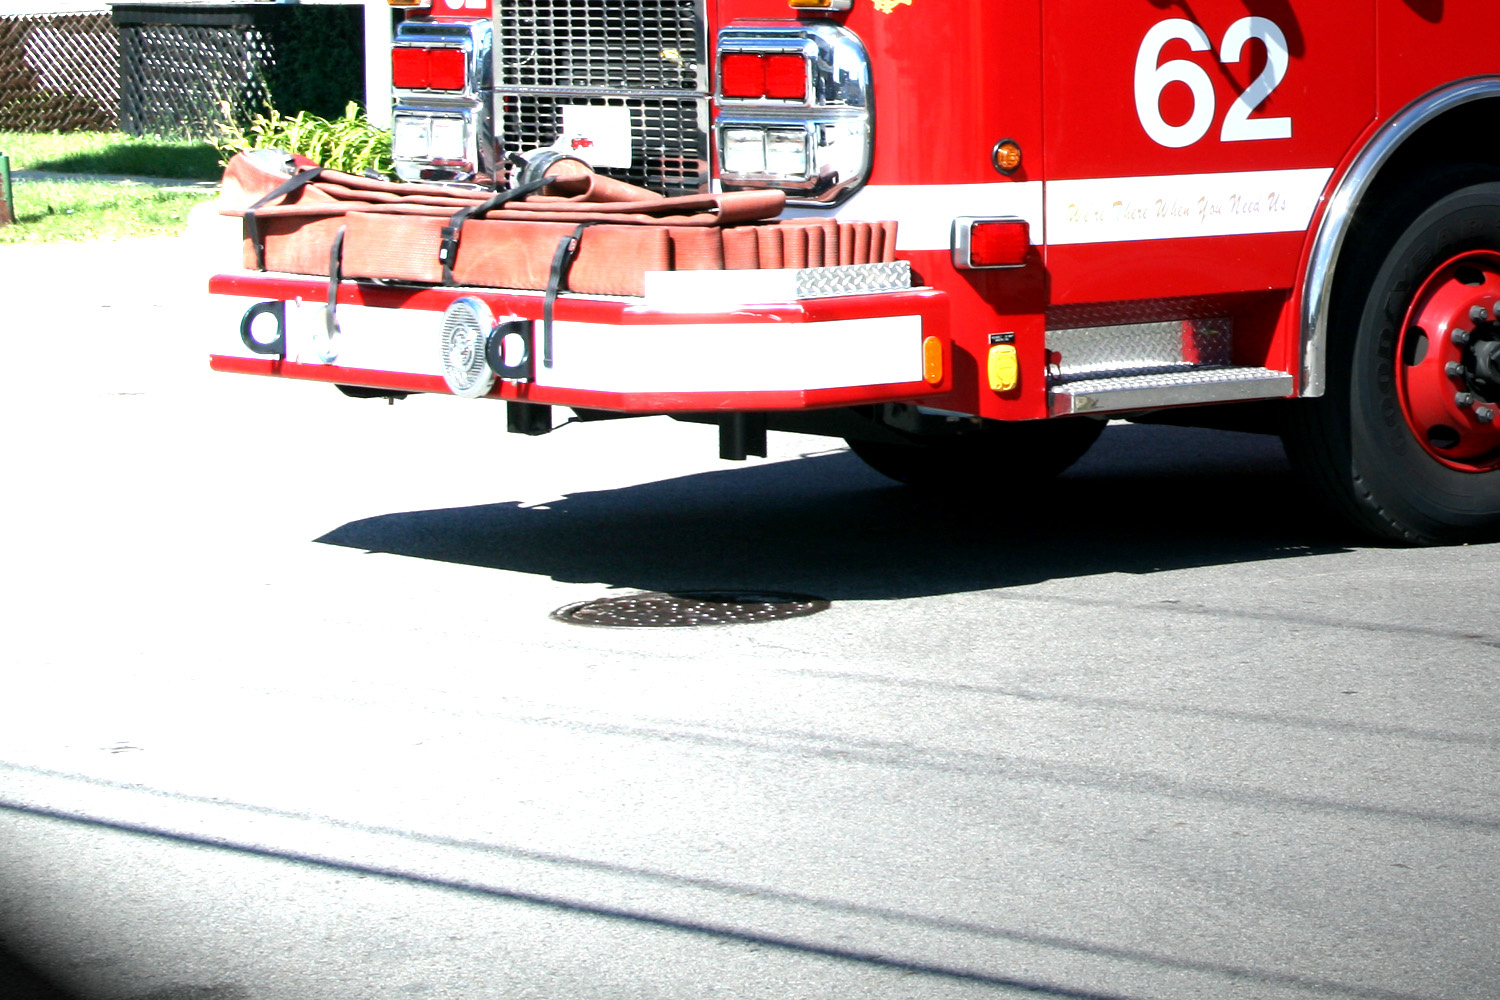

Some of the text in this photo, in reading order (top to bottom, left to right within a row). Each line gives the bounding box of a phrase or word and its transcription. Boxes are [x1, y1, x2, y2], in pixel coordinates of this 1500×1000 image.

[1133, 16, 1293, 148] 62
[1154, 198, 1190, 219] When
[1197, 195, 1223, 225] You
[1229, 193, 1261, 216] Need
[1267, 191, 1287, 212] Us
